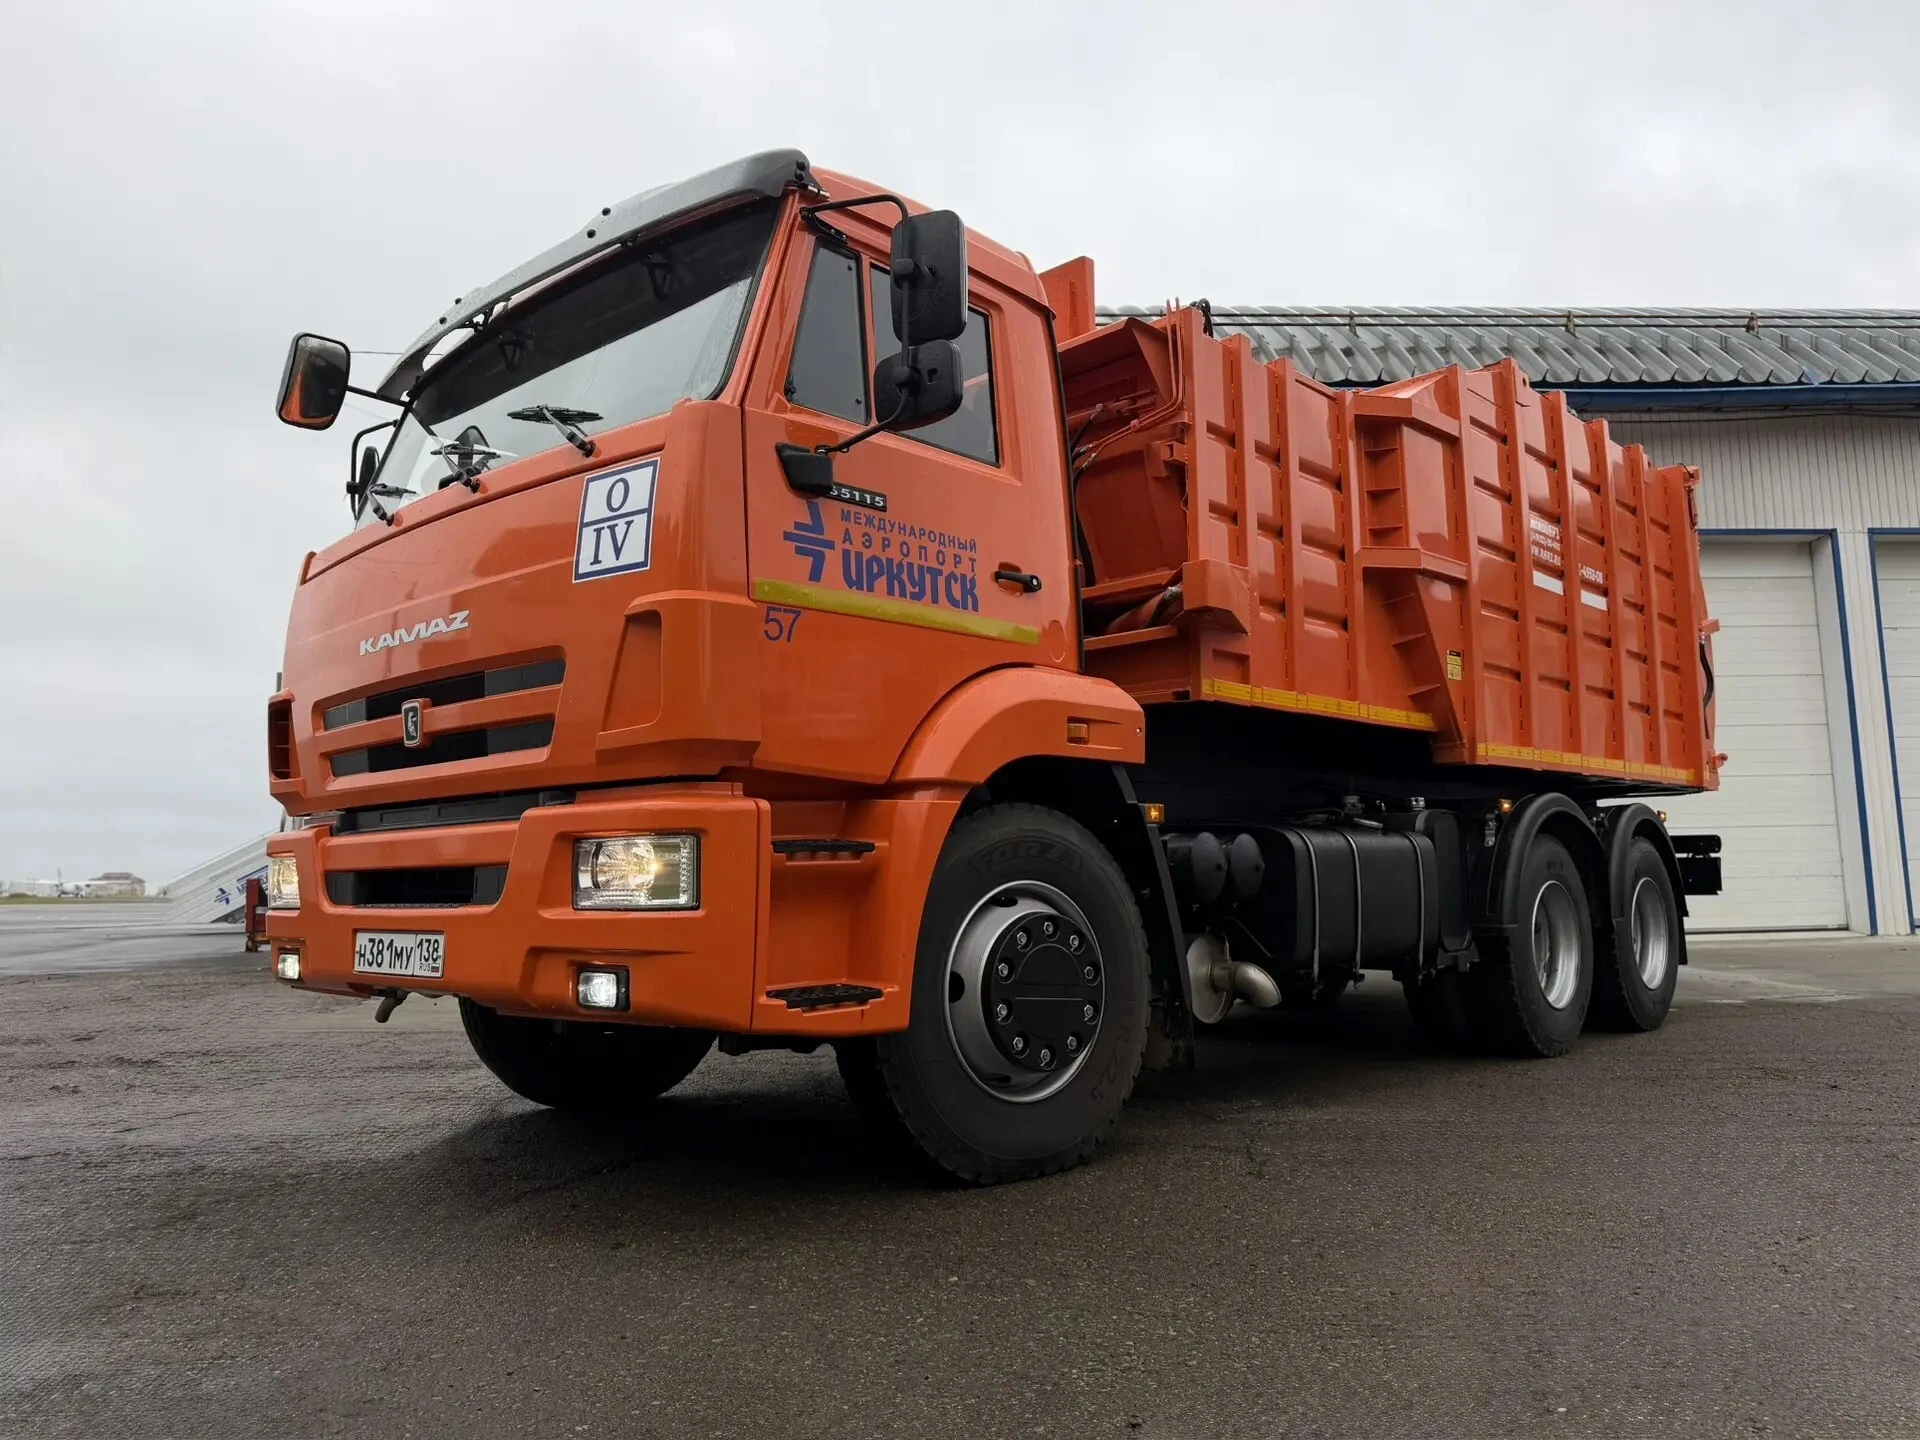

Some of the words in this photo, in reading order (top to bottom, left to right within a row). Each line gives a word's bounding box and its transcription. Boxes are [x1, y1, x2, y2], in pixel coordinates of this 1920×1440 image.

[589, 519, 635, 566] IV
[840, 508, 977, 554] МЕЖДУНАРОДНЫЙ
[841, 527, 977, 574] АЭРОПОРТ
[841, 548, 979, 613] ИРКУТСК
[359, 609, 470, 656] KAMAZ
[763, 605, 802, 643] 57
[416, 937, 440, 963] 138
[418, 962, 431, 972] RUS
